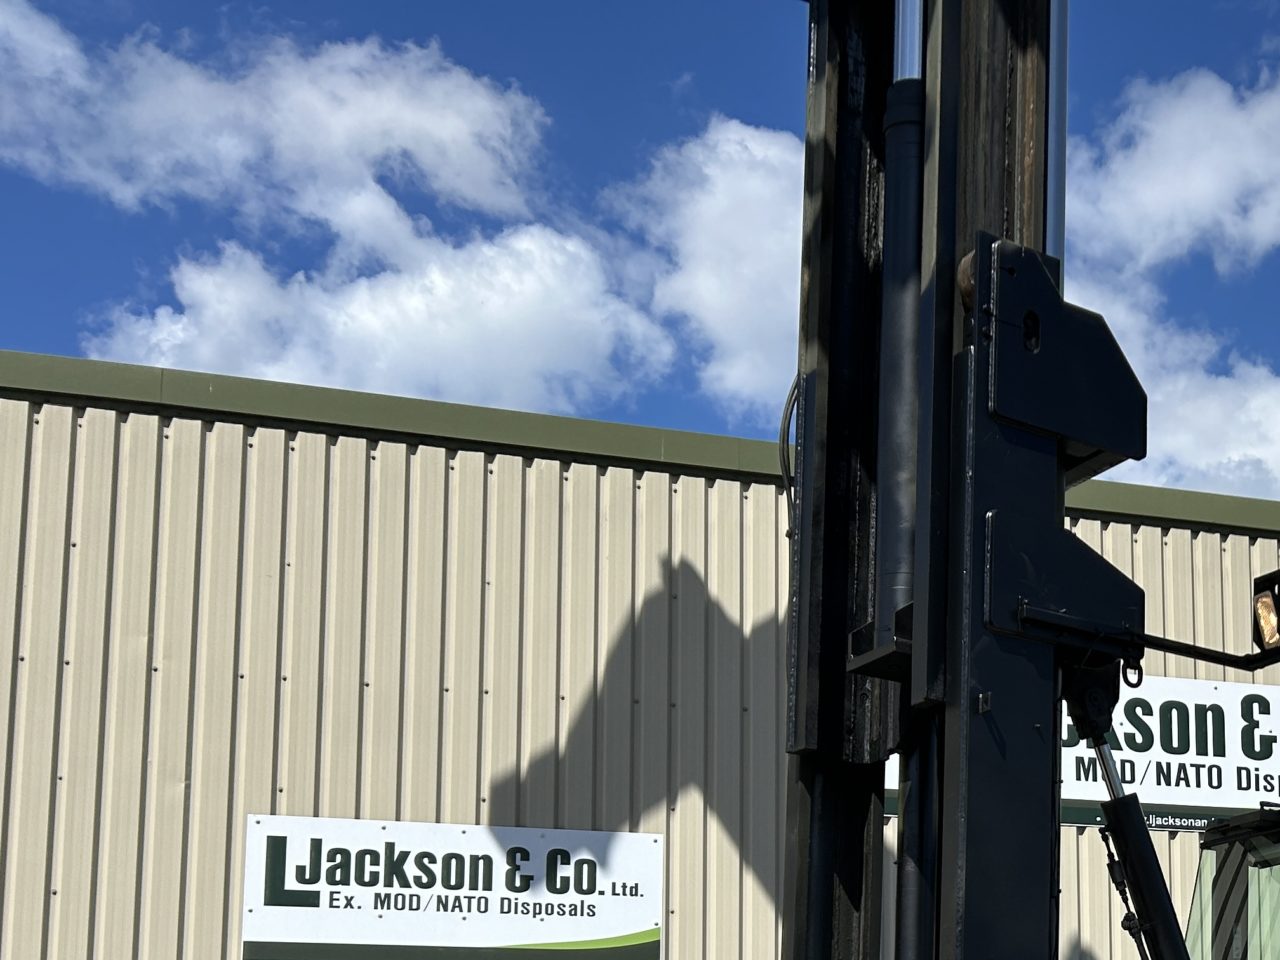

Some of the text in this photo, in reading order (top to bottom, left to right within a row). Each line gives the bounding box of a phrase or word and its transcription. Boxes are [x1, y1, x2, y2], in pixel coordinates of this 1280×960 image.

[1240, 693, 1278, 761] &
[1075, 756, 1223, 790] MD/NATO
[505, 846, 535, 893] &
[545, 848, 606, 896] Co.
[611, 881, 645, 898] Ltd.
[329, 890, 597, 918] Ex. MOD/NATO Disposals
